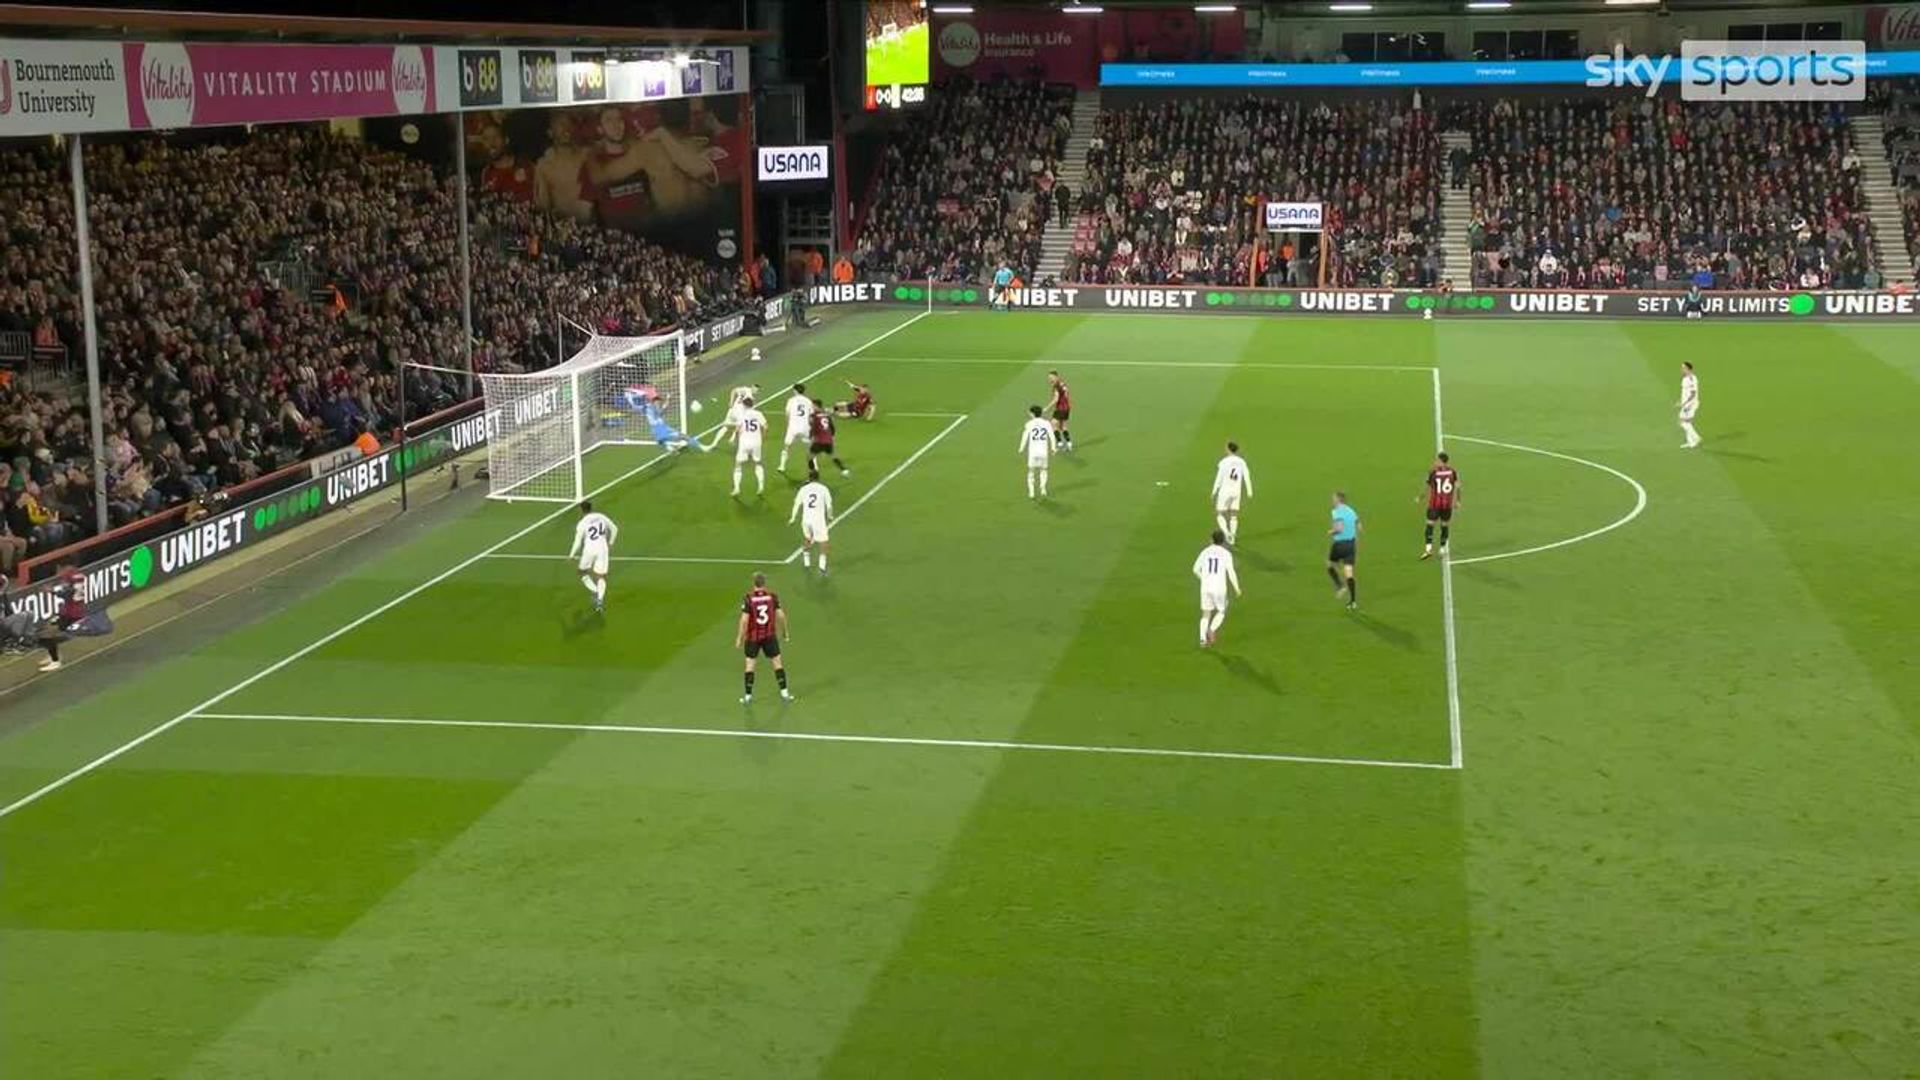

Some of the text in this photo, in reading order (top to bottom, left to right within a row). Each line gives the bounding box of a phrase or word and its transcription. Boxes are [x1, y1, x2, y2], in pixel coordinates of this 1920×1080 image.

[984, 31, 1029, 46] Health
[1045, 31, 1072, 47] Life
[15, 59, 115, 81] Bournemouth
[143, 57, 192, 113] Vitality
[204, 69, 386, 97] VITALITY STADIUM
[18, 88, 95, 118] University
[764, 152, 821, 173] USANA
[1268, 207, 1320, 219] USANA
[810, 283, 886, 304] UNIBET
[1105, 289, 1196, 307] UNIBET
[1300, 291, 1394, 311] UNIBET
[1510, 293, 1608, 312] UNIBET
[1638, 297, 1790, 312] SET YUR LIMITS
[515, 388, 558, 425] UNIBET
[797, 405, 805, 417] 5
[451, 409, 501, 451] UNIBET
[744, 419, 758, 432] 15
[1032, 428, 1047, 441] 22
[327, 454, 389, 505] UNIBET
[1229, 469, 1238, 481] 4
[1435, 478, 1452, 494] 16
[808, 494, 817, 508] 2
[588, 523, 606, 541] 24
[160, 511, 246, 573] UNIBET
[1208, 558, 1219, 573] 11
[84, 560, 131, 604] IMITS
[756, 604, 769, 625] 3
